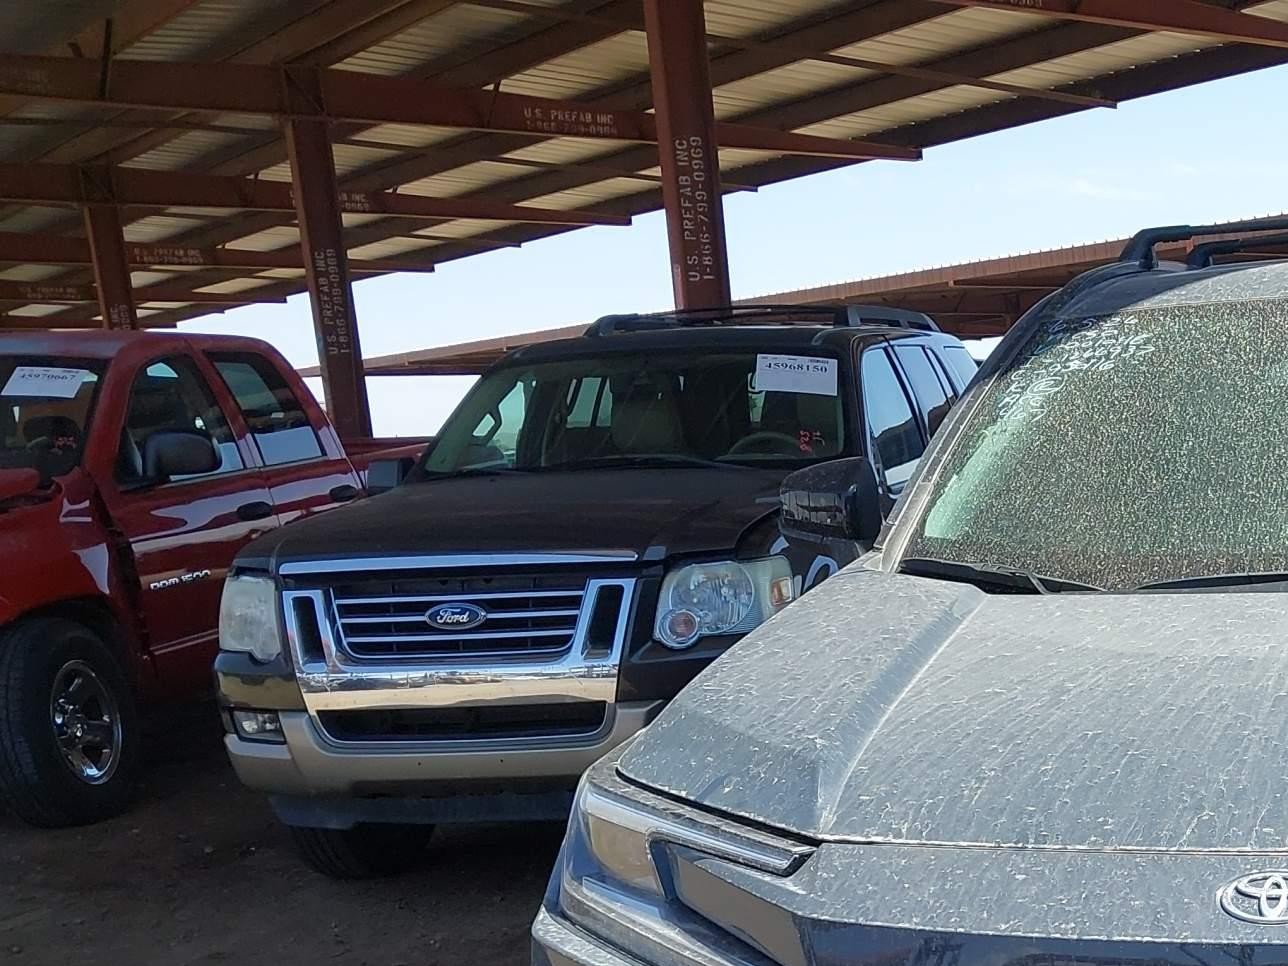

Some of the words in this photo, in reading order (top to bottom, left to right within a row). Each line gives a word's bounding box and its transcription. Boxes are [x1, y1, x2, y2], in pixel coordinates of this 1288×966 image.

[550, 110, 592, 123] PREFAB
[678, 175, 697, 240] PREFAB
[690, 136, 715, 280] 1-866-799-0969
[687, 250, 700, 281] U.S.
[318, 277, 334, 325] PREFAB
[765, 362, 828, 373] 45968150
[436, 608, 470, 623] Ford
